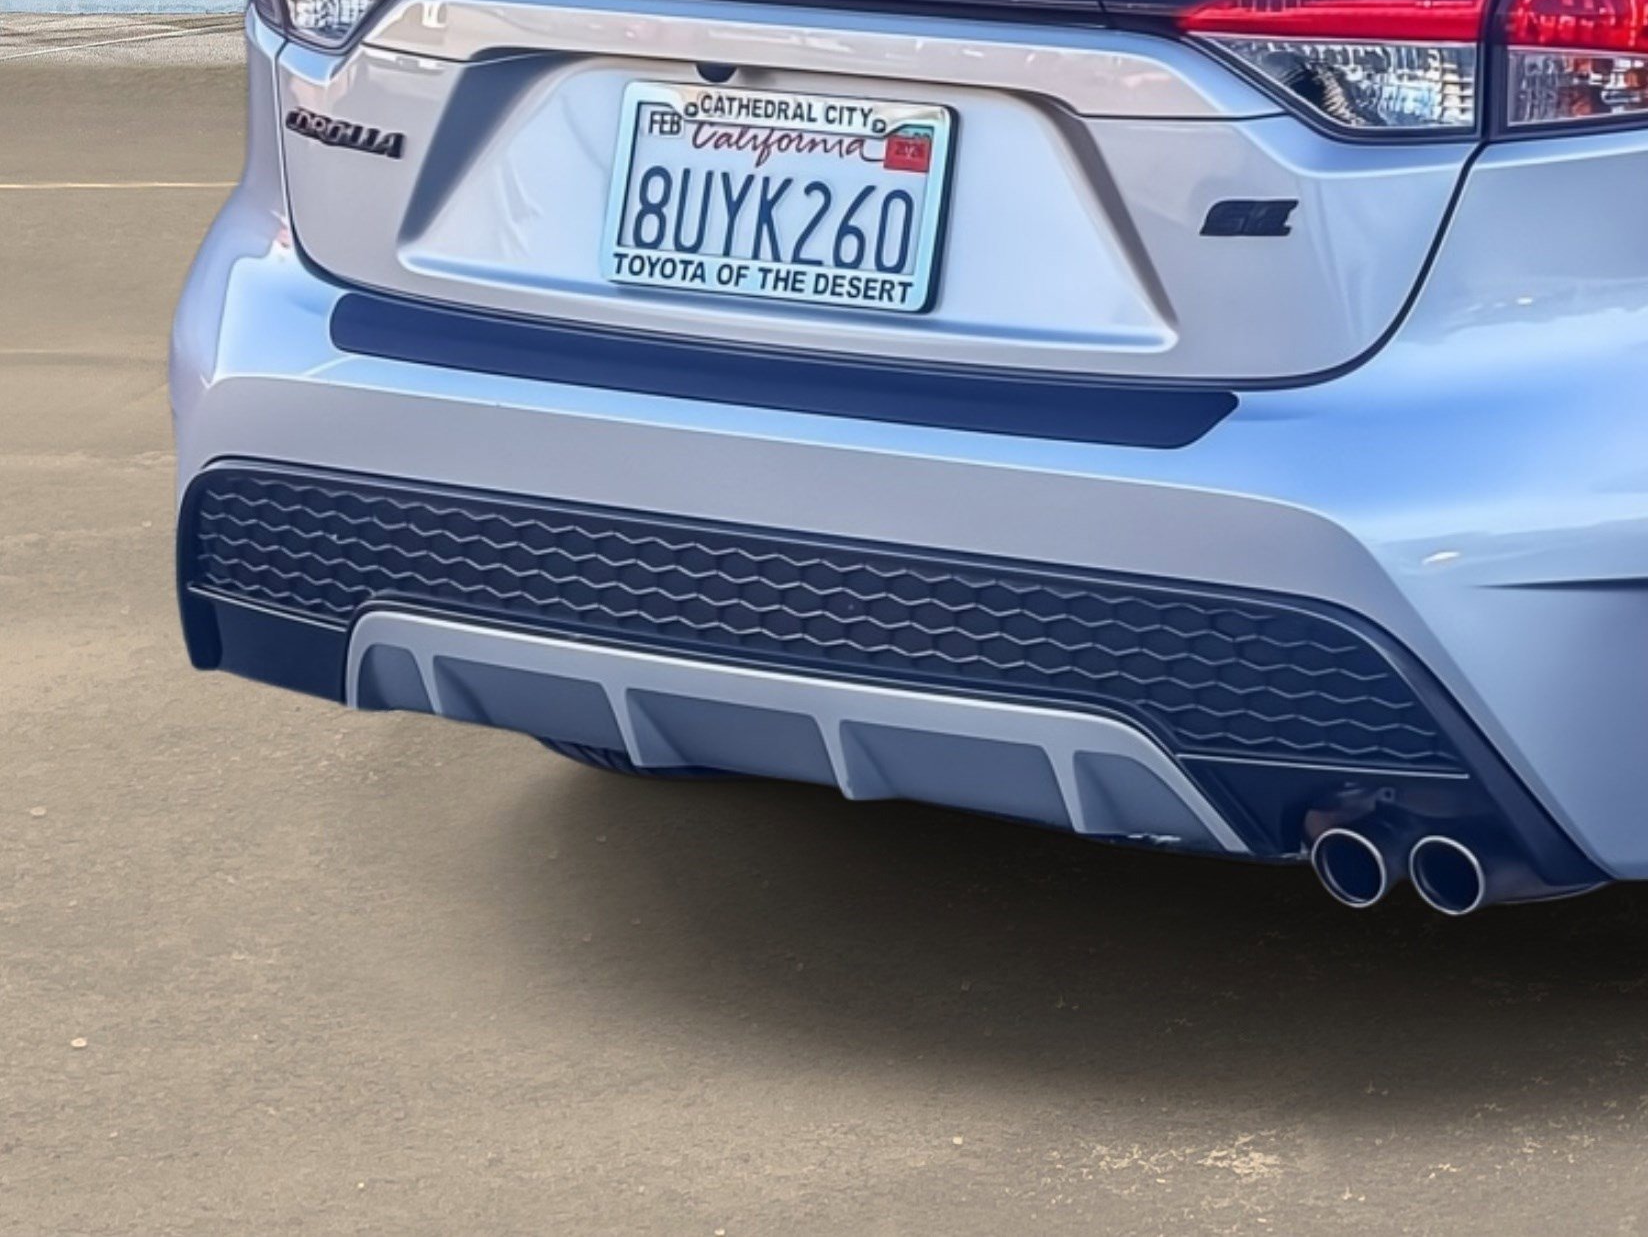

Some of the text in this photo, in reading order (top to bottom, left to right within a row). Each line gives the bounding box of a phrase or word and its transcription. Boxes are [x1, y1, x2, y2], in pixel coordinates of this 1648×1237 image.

[648, 110, 682, 136] FEB
[700, 94, 874, 128] CATHEDRAL CITY
[692, 122, 884, 168] California
[632, 165, 914, 275] 8UYK260
[613, 252, 913, 305] TOYOTA OF THE DESERT
